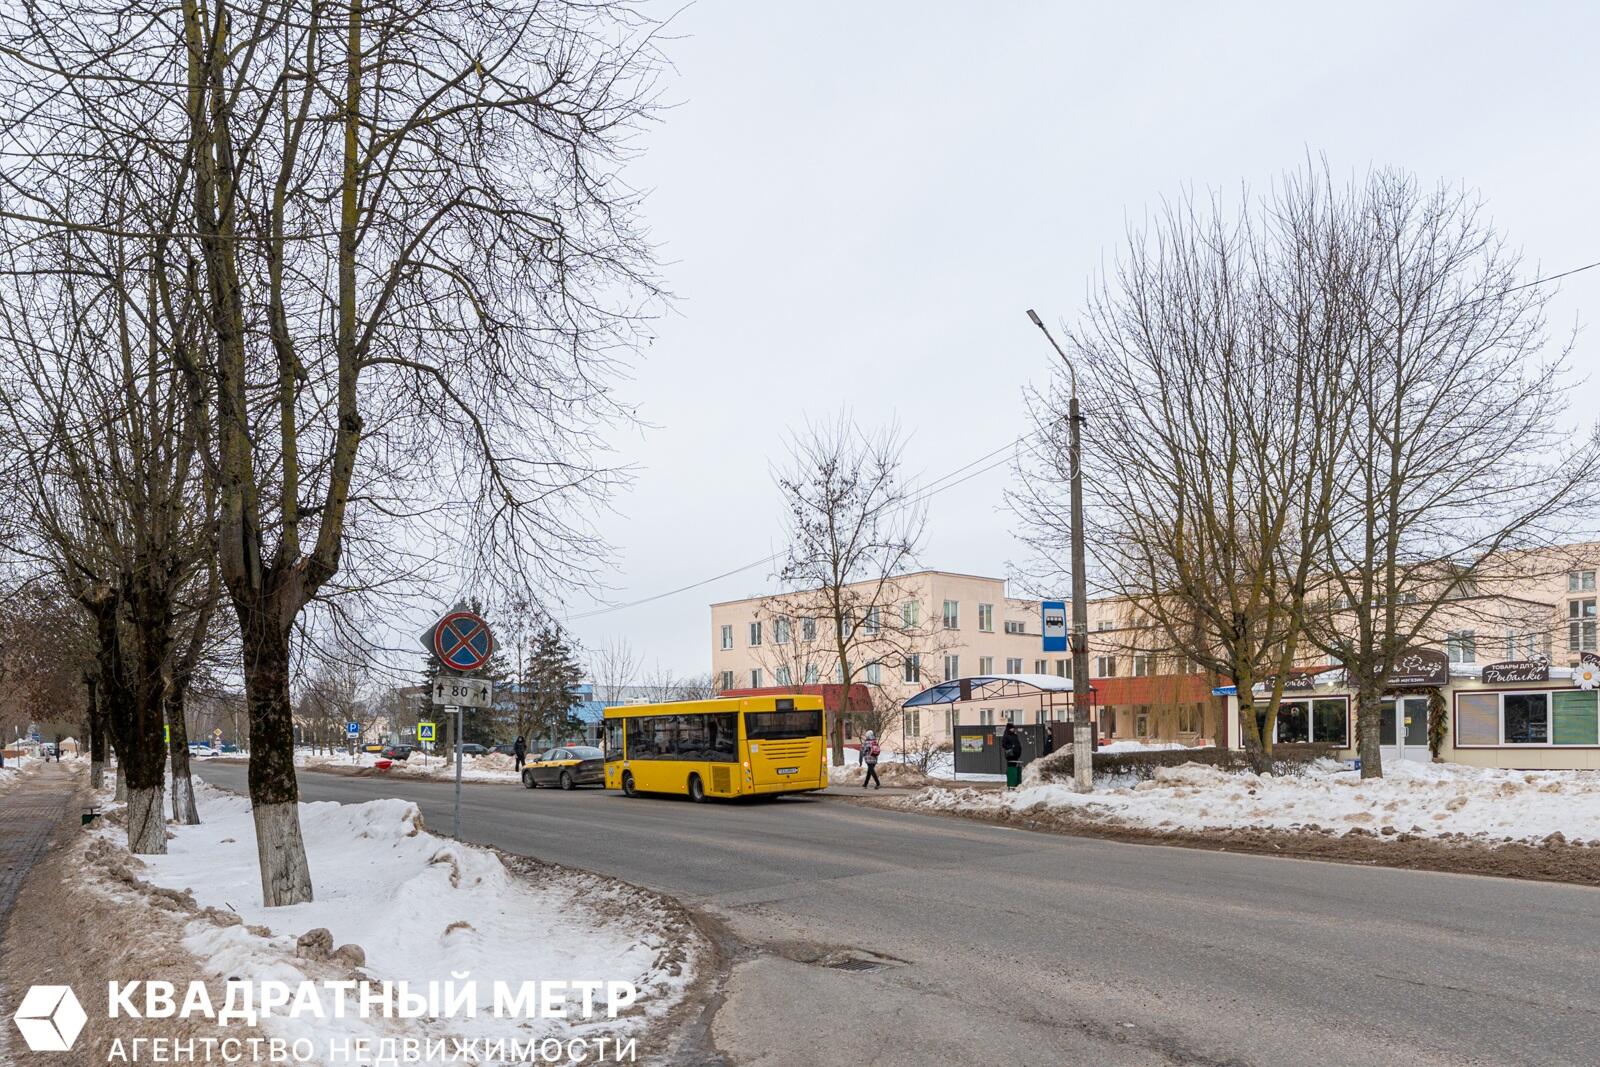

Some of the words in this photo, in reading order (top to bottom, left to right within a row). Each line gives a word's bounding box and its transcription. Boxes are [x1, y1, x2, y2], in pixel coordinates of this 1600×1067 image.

[1486, 667, 1543, 683] Рыбалки
[452, 686, 468, 697] 80
[350, 723, 357, 732] P
